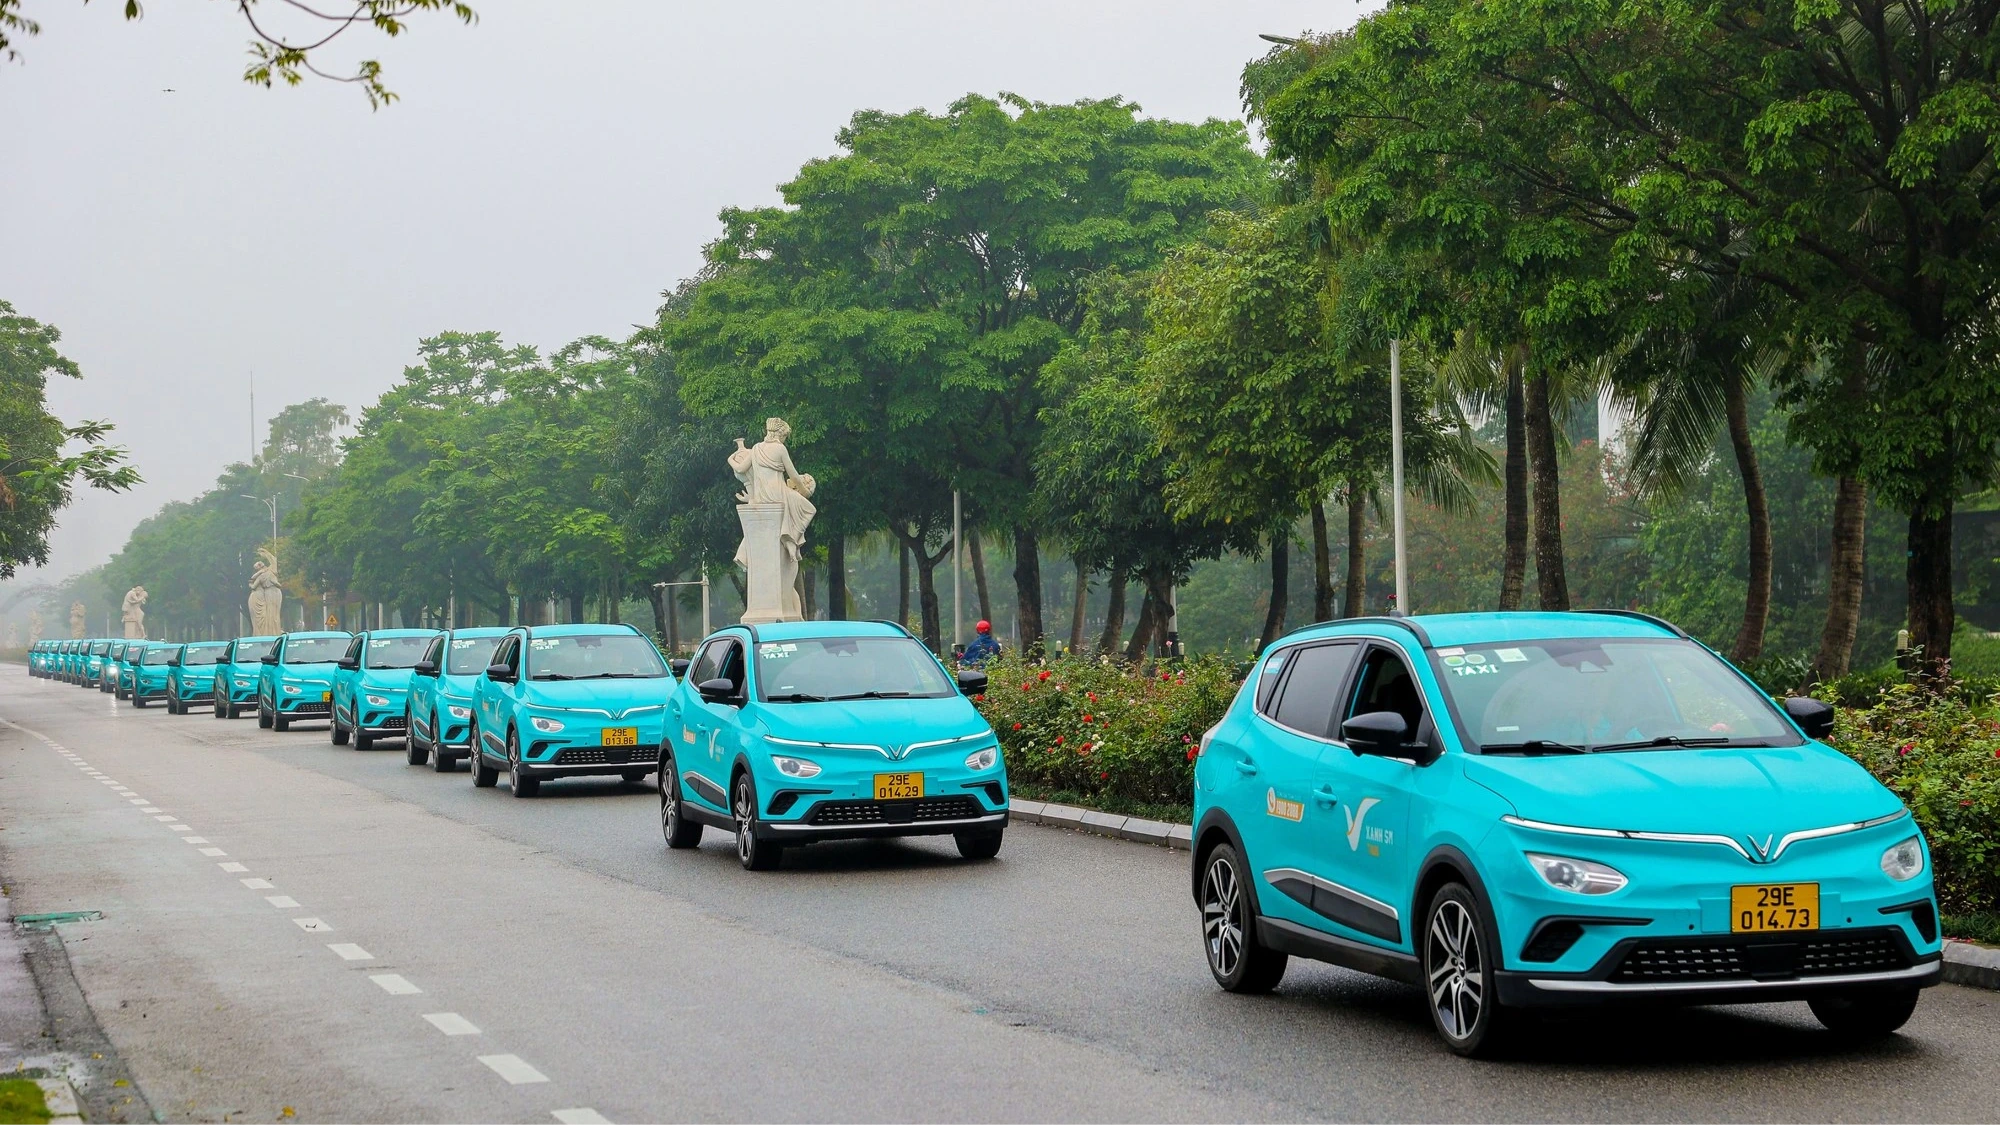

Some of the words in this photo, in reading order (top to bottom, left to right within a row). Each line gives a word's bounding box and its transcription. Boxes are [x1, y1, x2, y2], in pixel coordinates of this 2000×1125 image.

[1453, 664, 1498, 676] TAXI
[611, 728, 628, 737] 29E
[605, 737, 634, 745] 013.86
[888, 774, 910, 786] 29E
[879, 786, 919, 798] 014.29
[1366, 826, 1383, 842] XANH
[1384, 829, 1393, 845] SM
[1757, 887, 1795, 907] 29E
[1741, 909, 1810, 930] 014.73
